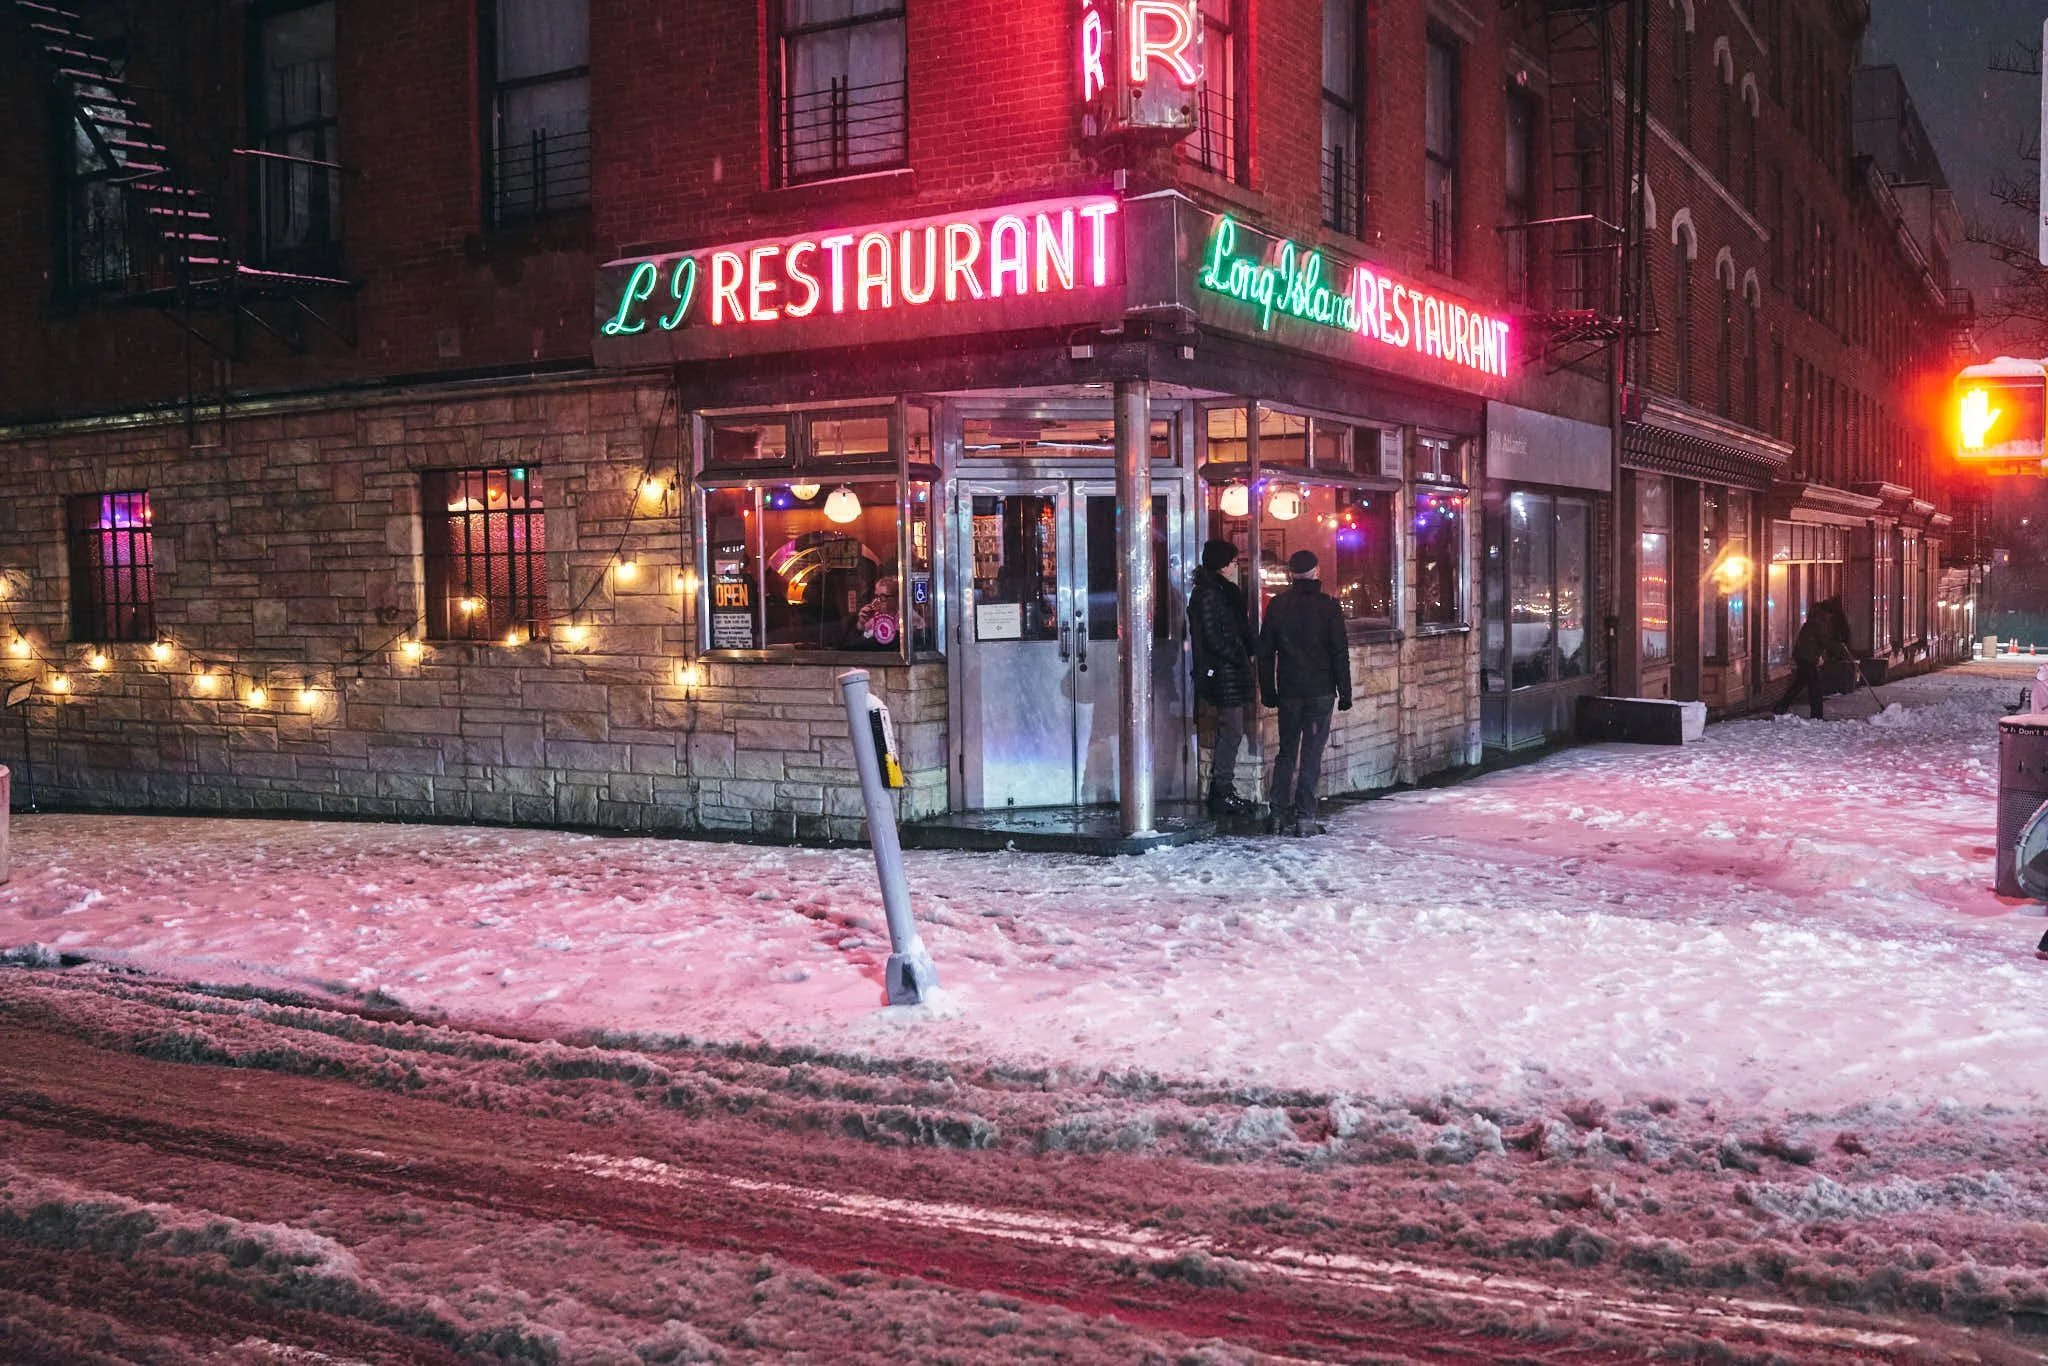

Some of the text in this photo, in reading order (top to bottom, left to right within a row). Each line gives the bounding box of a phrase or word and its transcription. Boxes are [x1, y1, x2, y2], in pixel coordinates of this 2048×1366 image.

[1083, 0, 1105, 102] R
[712, 202, 1118, 325] RESTAURANT
[1203, 215, 1510, 378] Long Island RESTAURANT
[716, 584, 748, 607] OPEN
